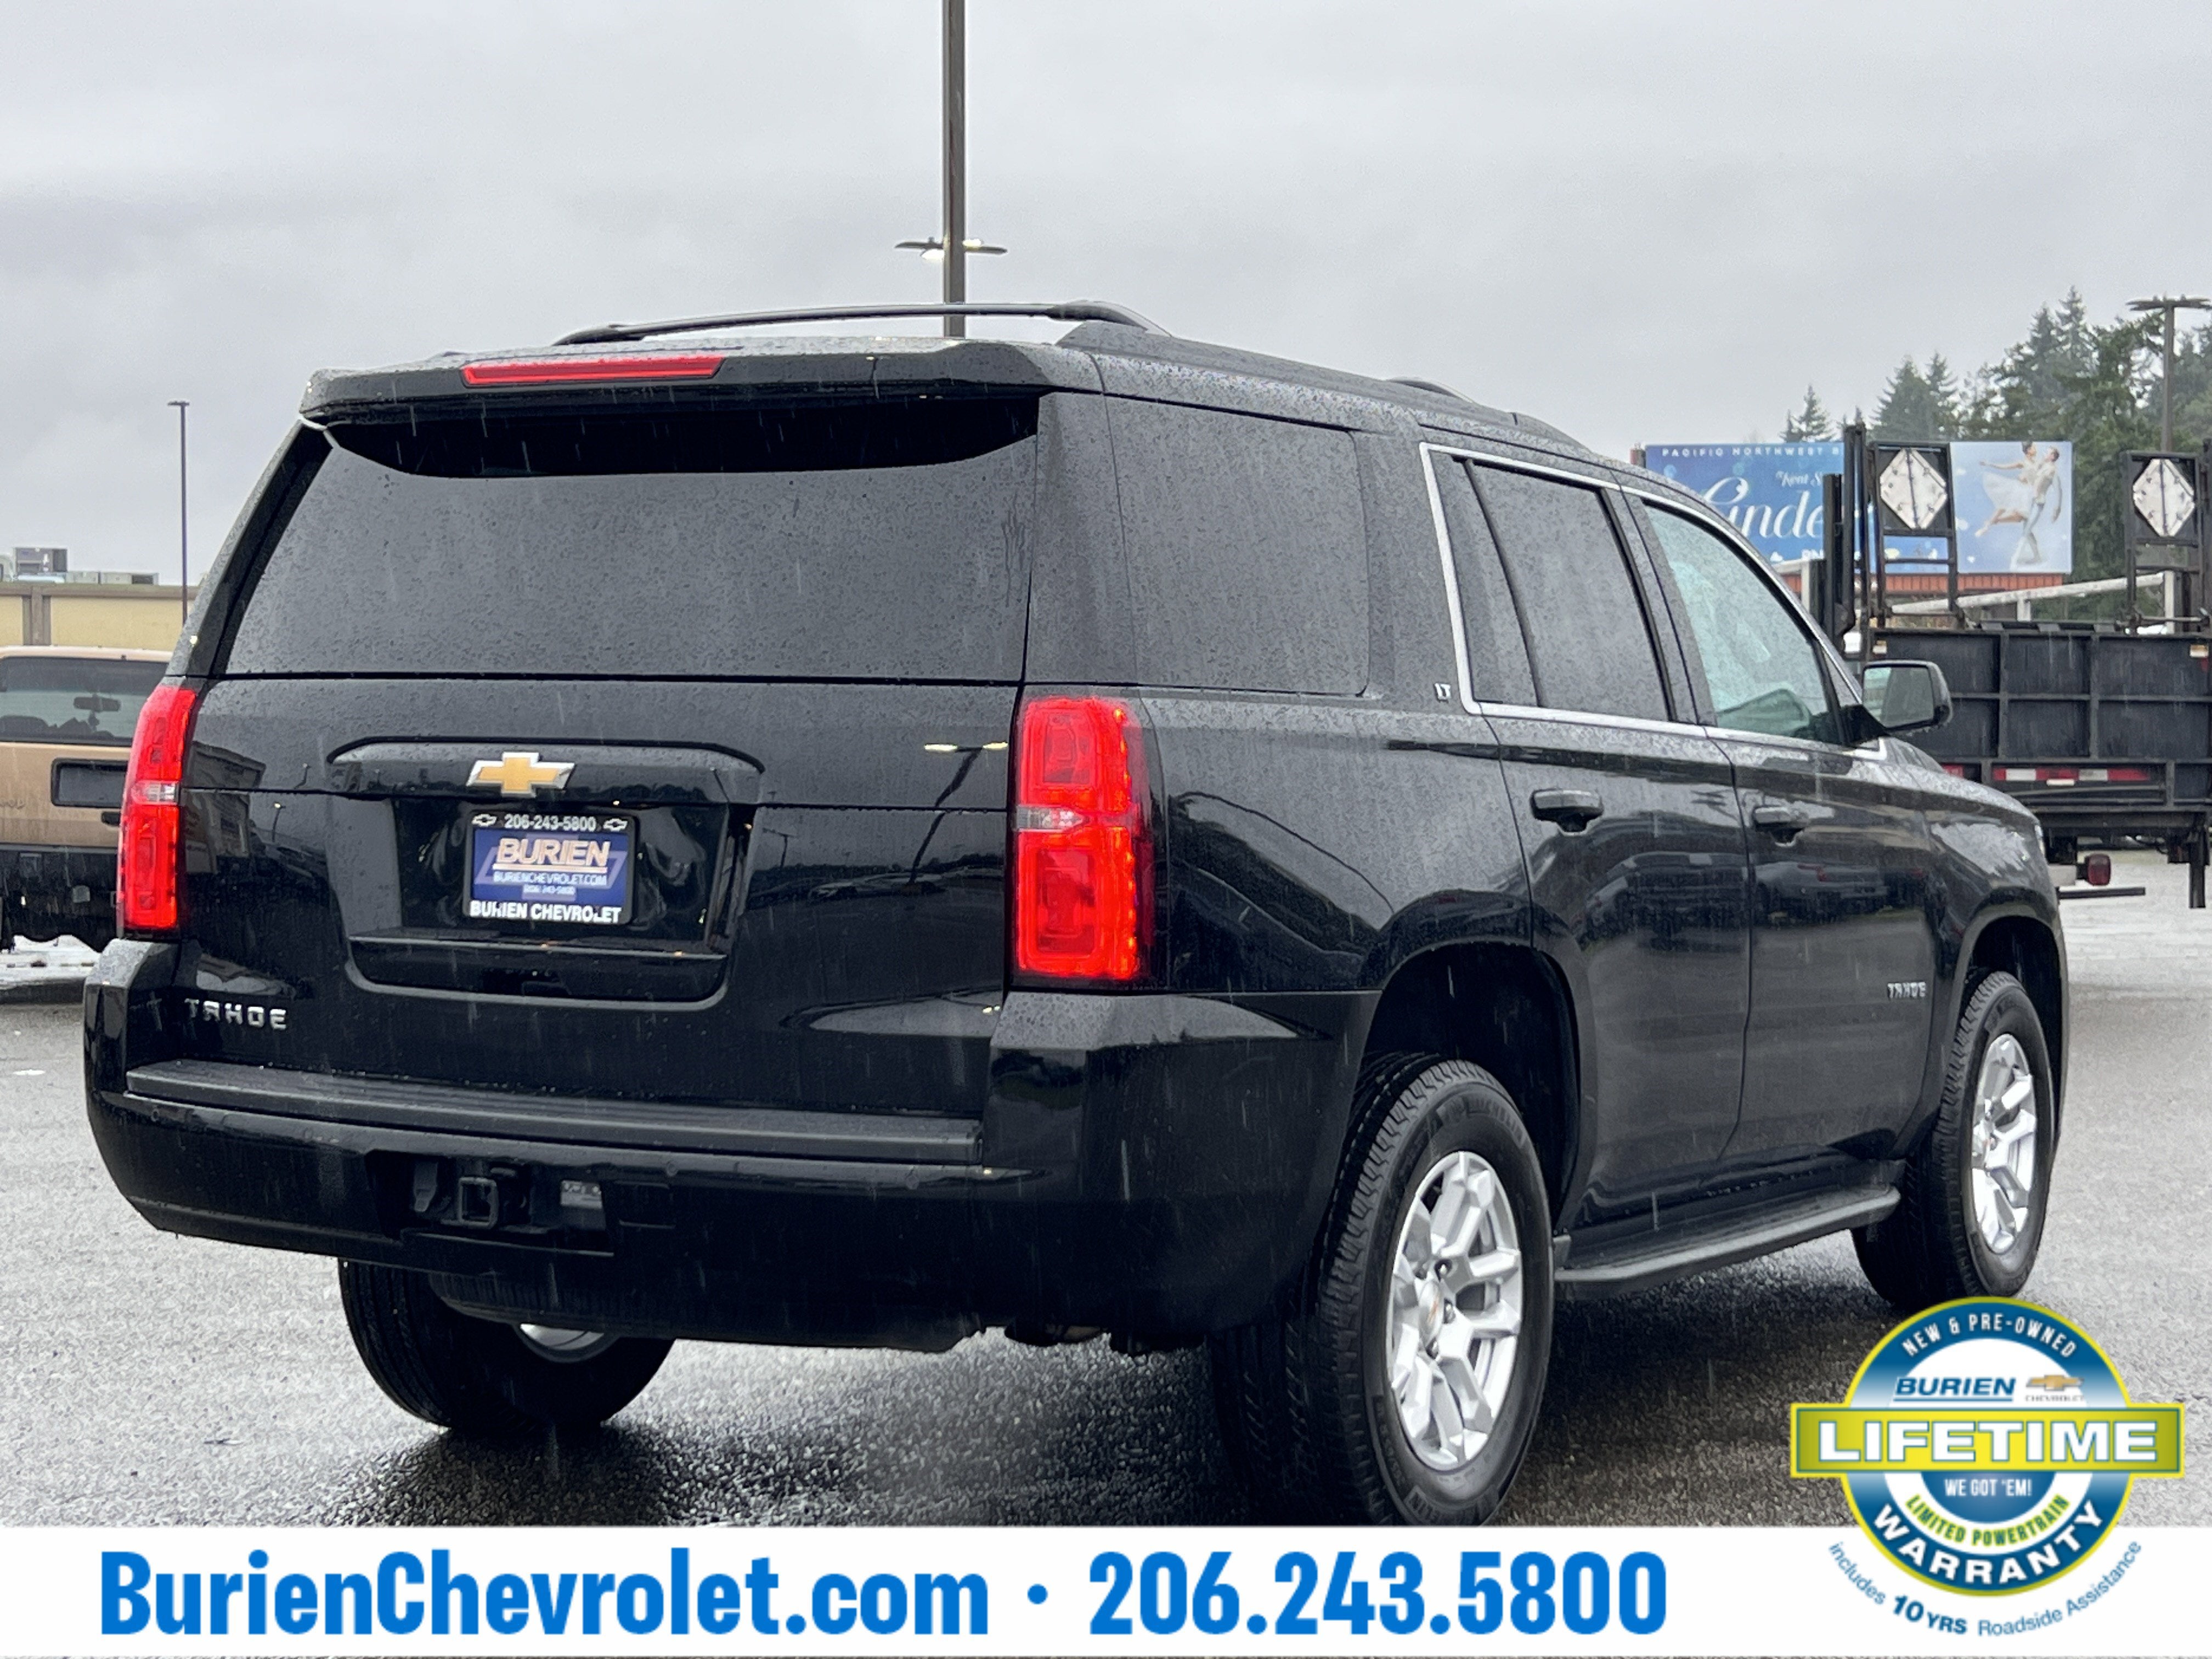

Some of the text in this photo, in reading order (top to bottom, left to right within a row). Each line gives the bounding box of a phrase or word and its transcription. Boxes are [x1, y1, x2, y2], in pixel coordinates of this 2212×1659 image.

[1662, 447, 1724, 457] PACIFIC
[1732, 446, 1822, 456] NORTHWEST
[504, 814, 596, 831] 206-243-5800
[496, 837, 611, 867] BURIEN
[470, 900, 622, 924] BURIEN CHEVROLET
[1887, 981, 1926, 998] TAHOE
[184, 998, 287, 1030] TAHOE
